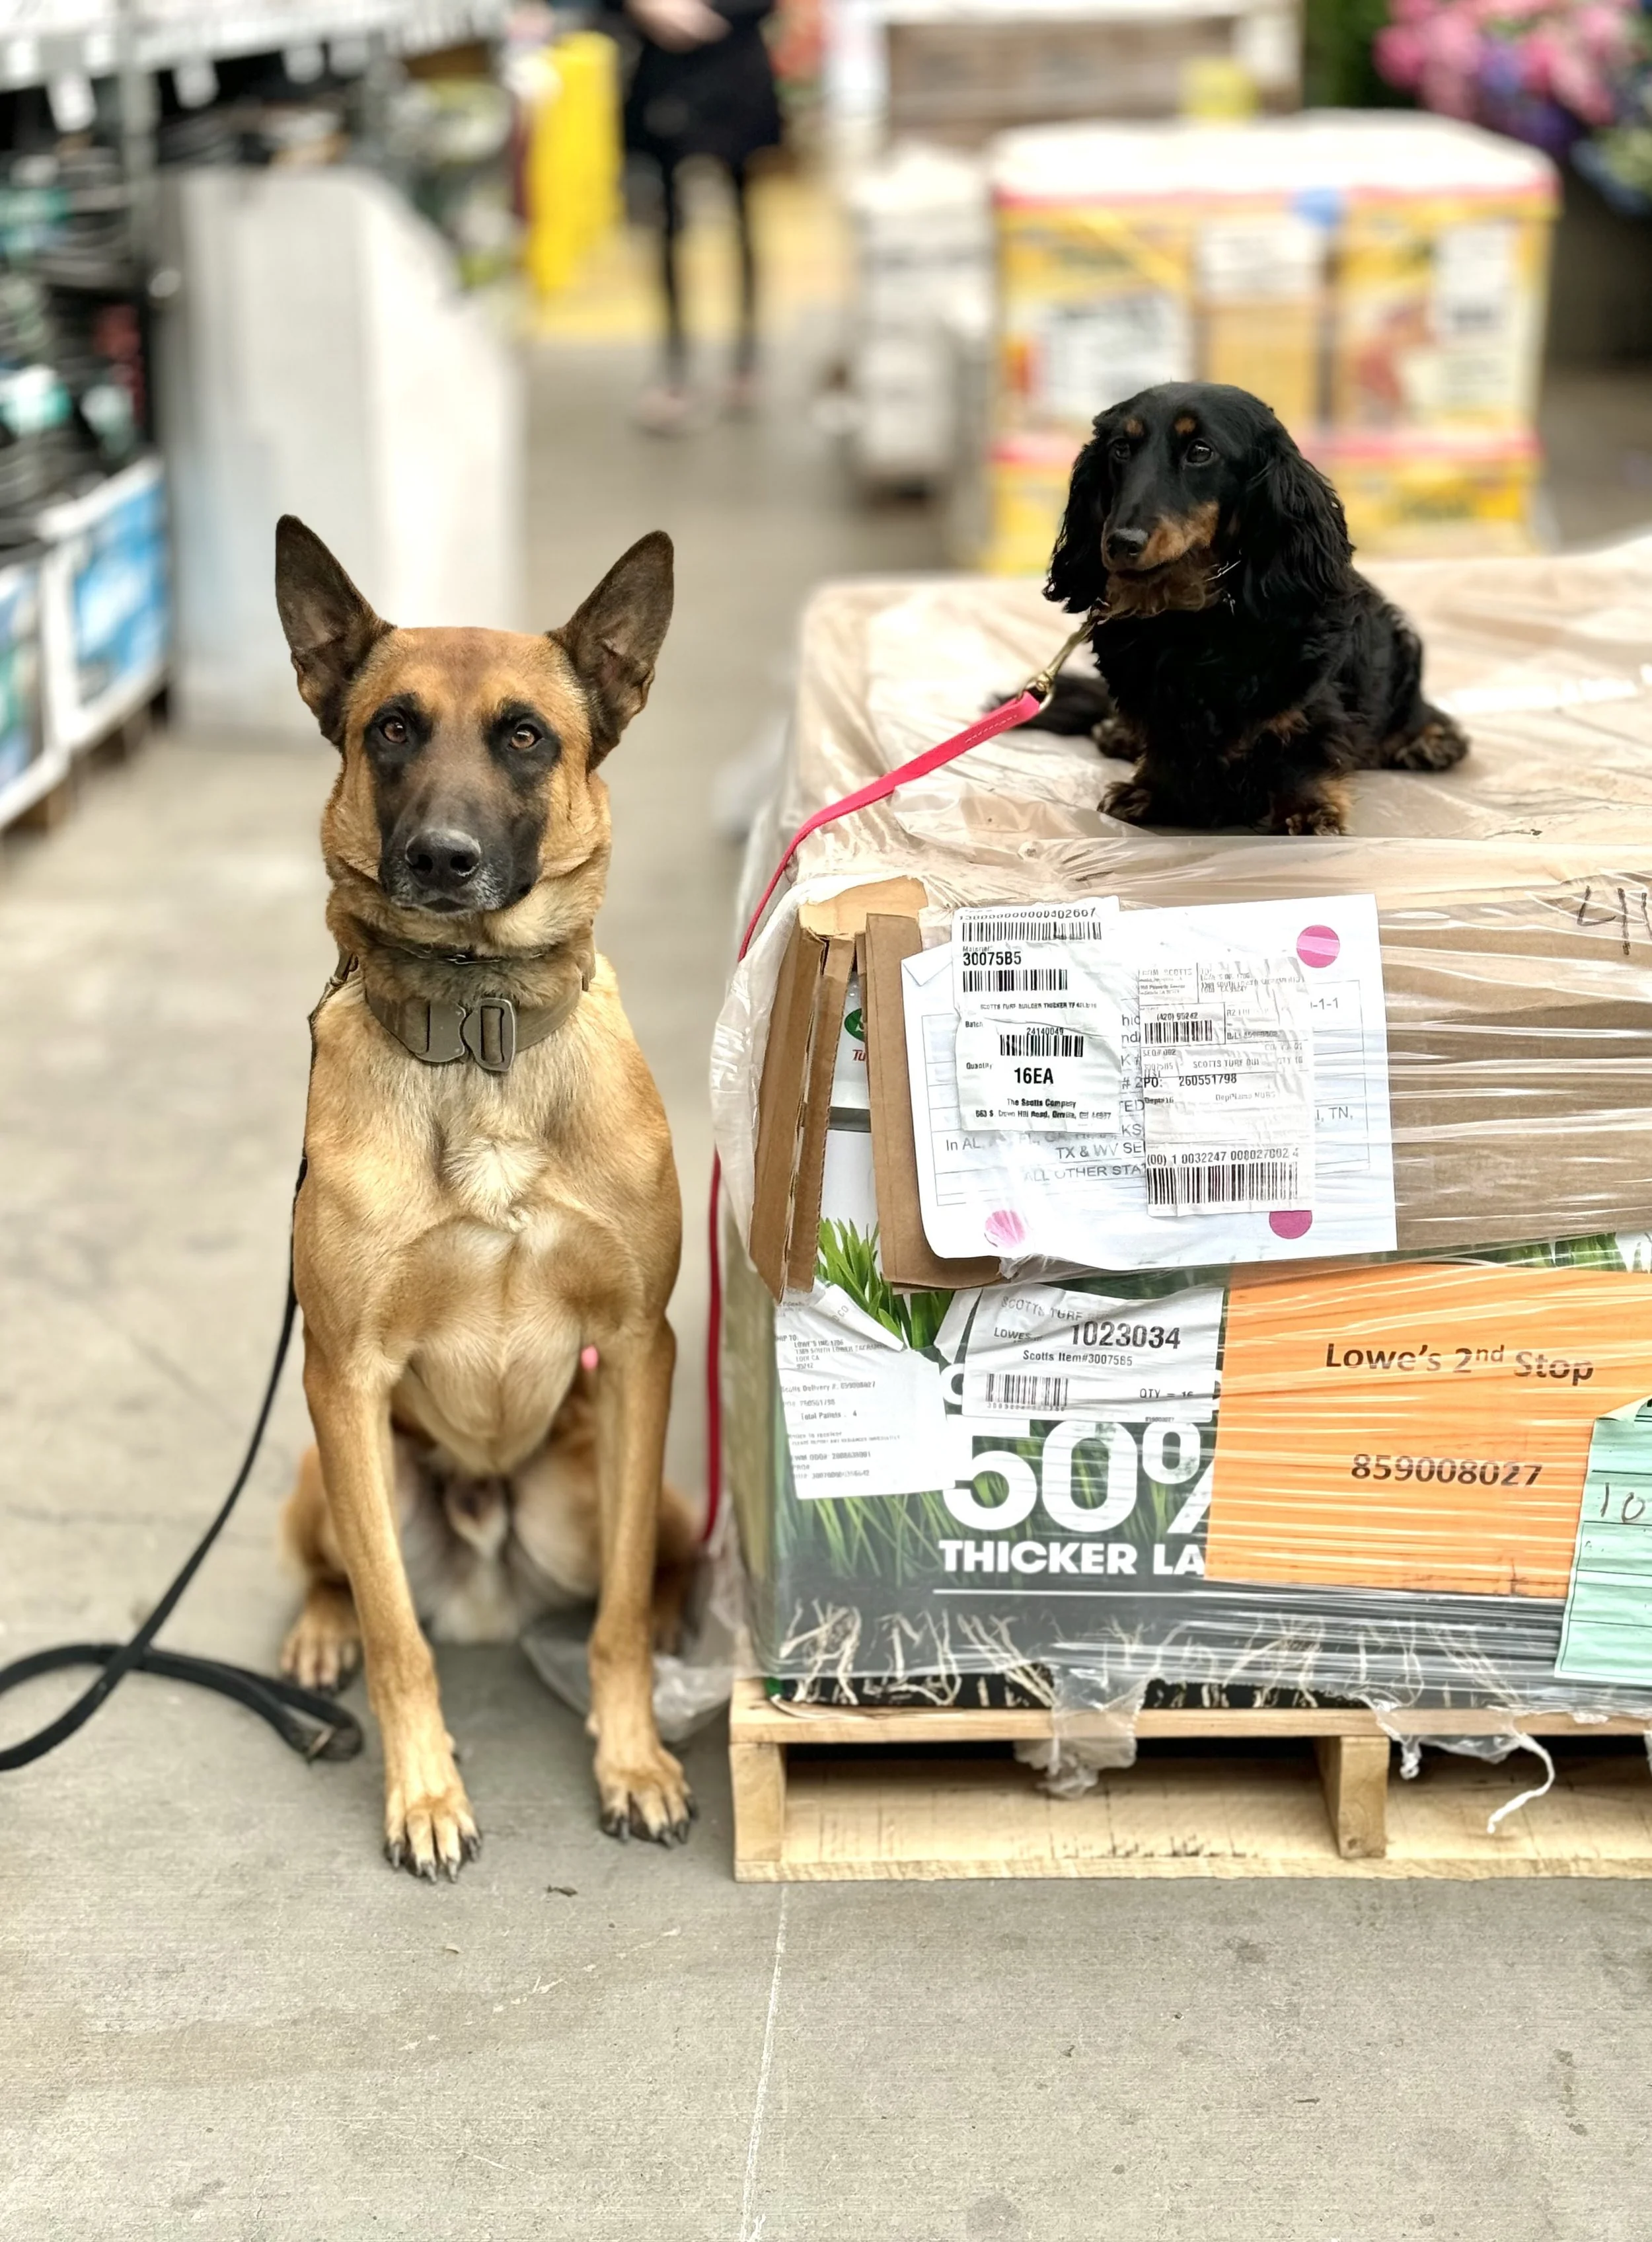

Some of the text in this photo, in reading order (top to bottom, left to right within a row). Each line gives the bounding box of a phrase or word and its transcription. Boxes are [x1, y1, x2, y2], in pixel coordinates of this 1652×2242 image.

[1014, 1067, 1054, 1085] 16EA
[1144, 1073, 1237, 1088] PO: 260551798
[946, 1140, 958, 1151] In
[1079, 1145, 1089, 1157] &
[1172, 1155, 1177, 1165] 1
[1182, 1151, 1226, 1164] 0032247
[1072, 1322, 1181, 1349] 1023034
[1326, 1344, 1594, 1385] Lowe's 2nd Stop
[1140, 1388, 1160, 1399] QTY
[1351, 1453, 1542, 1487] 859008027
[939, 1540, 1137, 1574] THICKER
